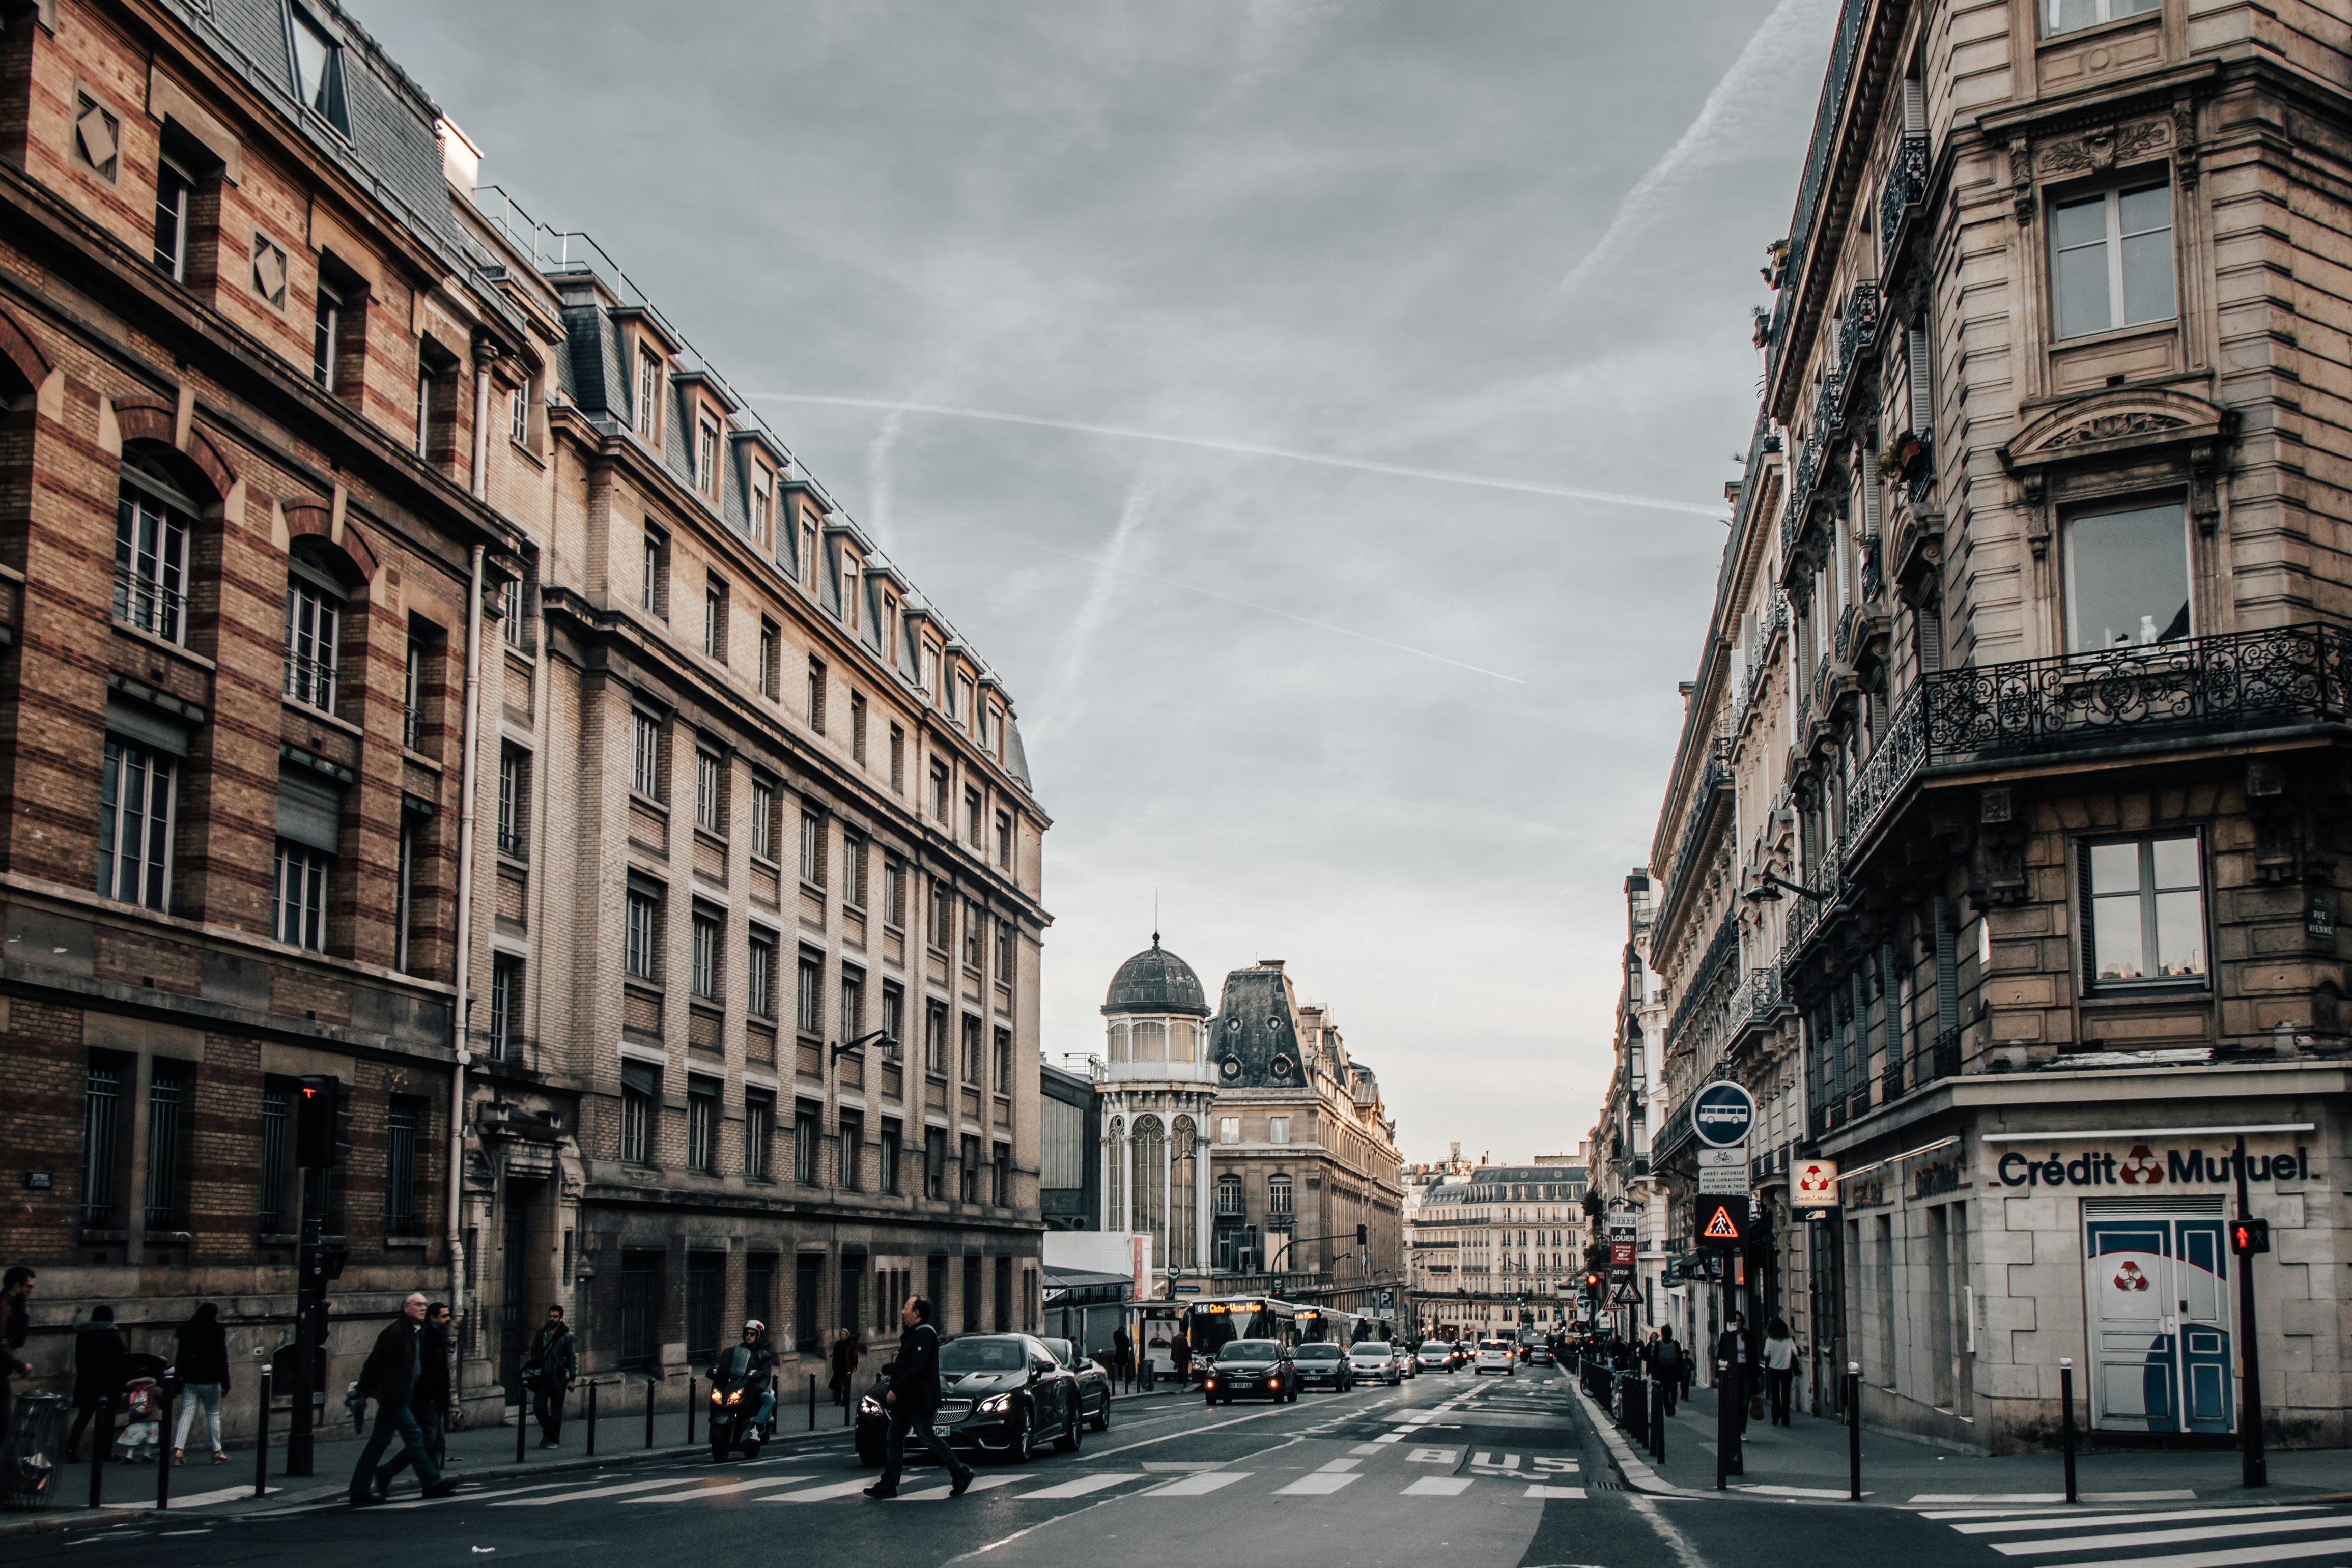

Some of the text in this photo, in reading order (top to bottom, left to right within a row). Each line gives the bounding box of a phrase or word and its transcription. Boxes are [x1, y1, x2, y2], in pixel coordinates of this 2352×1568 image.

[2313, 910, 2325, 919] RUE
[2309, 924, 2332, 934] VIENNE
[1998, 1152, 2117, 1186] Crédit
[1381, 1292, 1390, 1304] P
[1209, 1303, 1225, 1313] Clichy
[1229, 1303, 1246, 1312] Victor
[1246, 1302, 1262, 1312] Hugo
[1404, 1448, 1580, 1473] BUS
